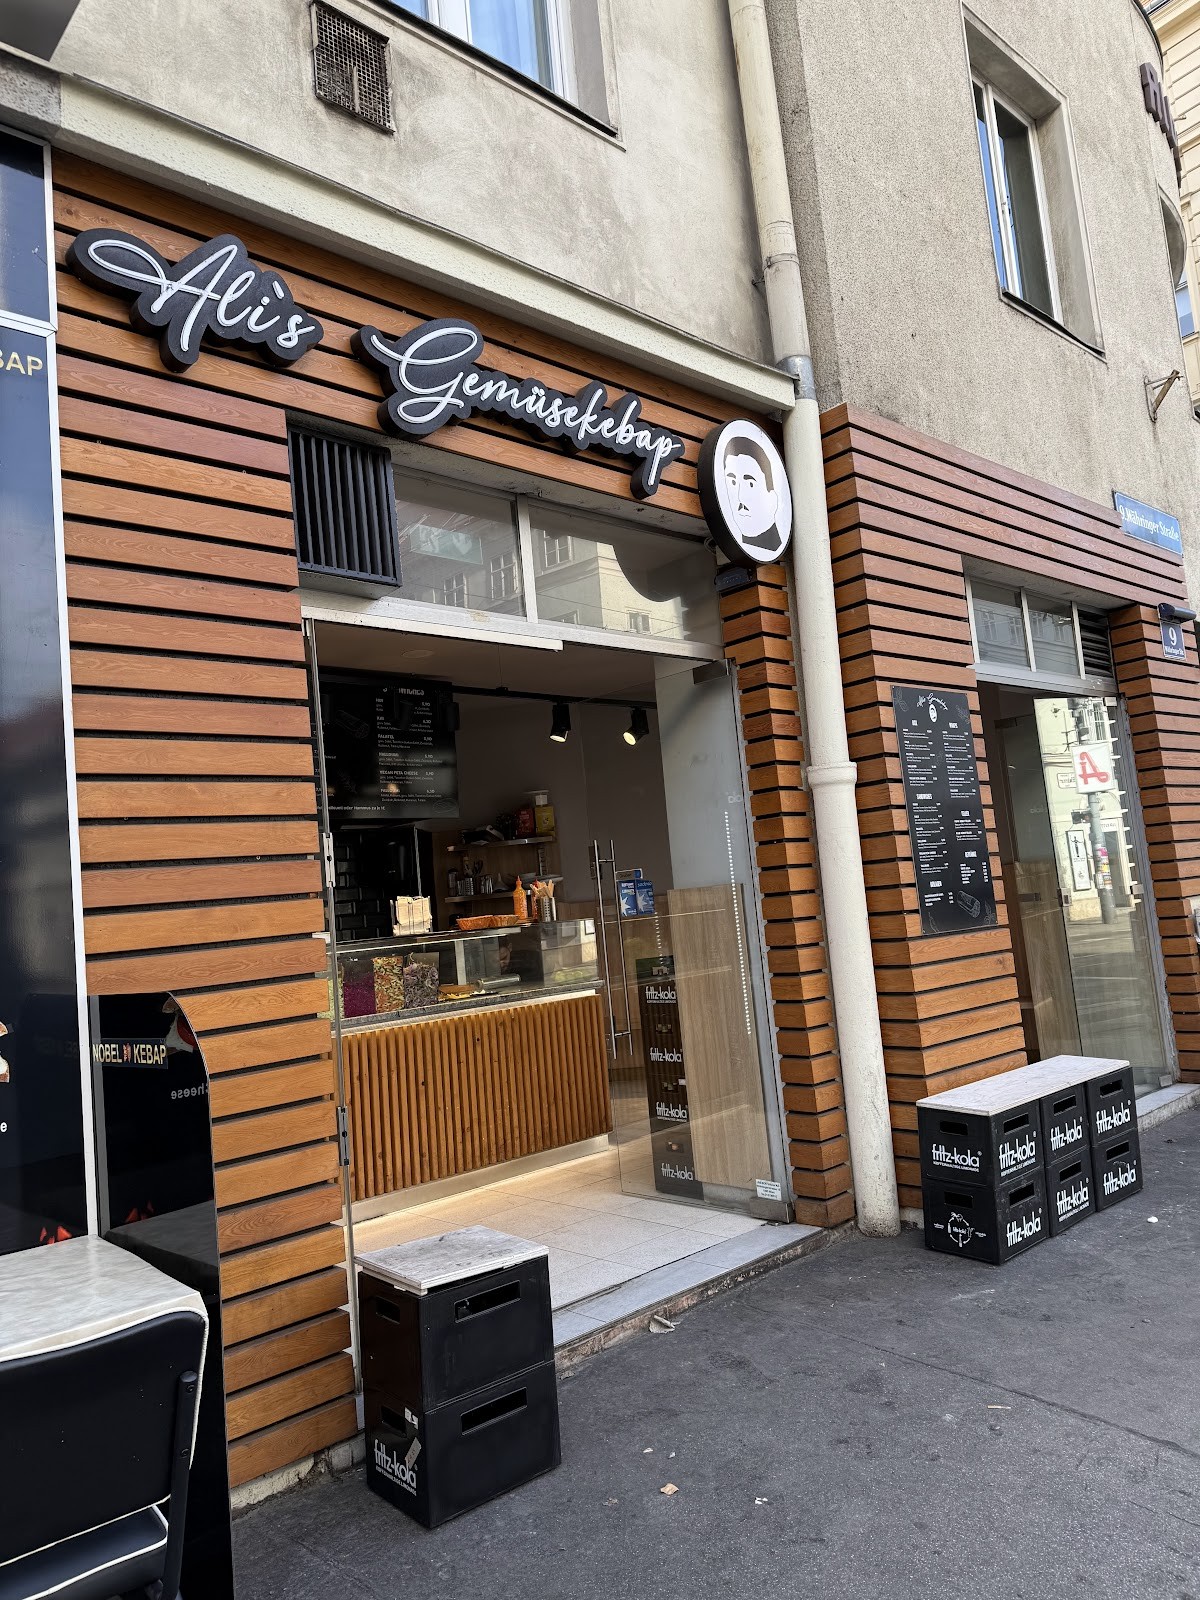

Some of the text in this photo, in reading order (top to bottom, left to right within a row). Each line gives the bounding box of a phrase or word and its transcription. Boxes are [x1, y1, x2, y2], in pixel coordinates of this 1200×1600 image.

[0, 349, 43, 376] AP
[371, 327, 681, 486] Gemüsekebap
[1169, 627, 1177, 646] 9
[645, 986, 676, 999] fritz-kola
[92, 1043, 167, 1065] NOBEL KEBAP
[650, 1047, 682, 1062] fritz-kola
[656, 1101, 688, 1119] fritz-kola
[1096, 1102, 1131, 1134] fritz-kola
[1051, 1119, 1082, 1151] fritz-kola
[932, 1143, 980, 1168] fritz-kola
[999, 1134, 1036, 1170] fritz-kola
[661, 1162, 694, 1181] fritz-kola
[1103, 1163, 1136, 1196] fritz-kola
[1057, 1180, 1089, 1216] fritz-kola
[1007, 1211, 1041, 1248] fritz-kola
[374, 1438, 417, 1489] fritz-kola
